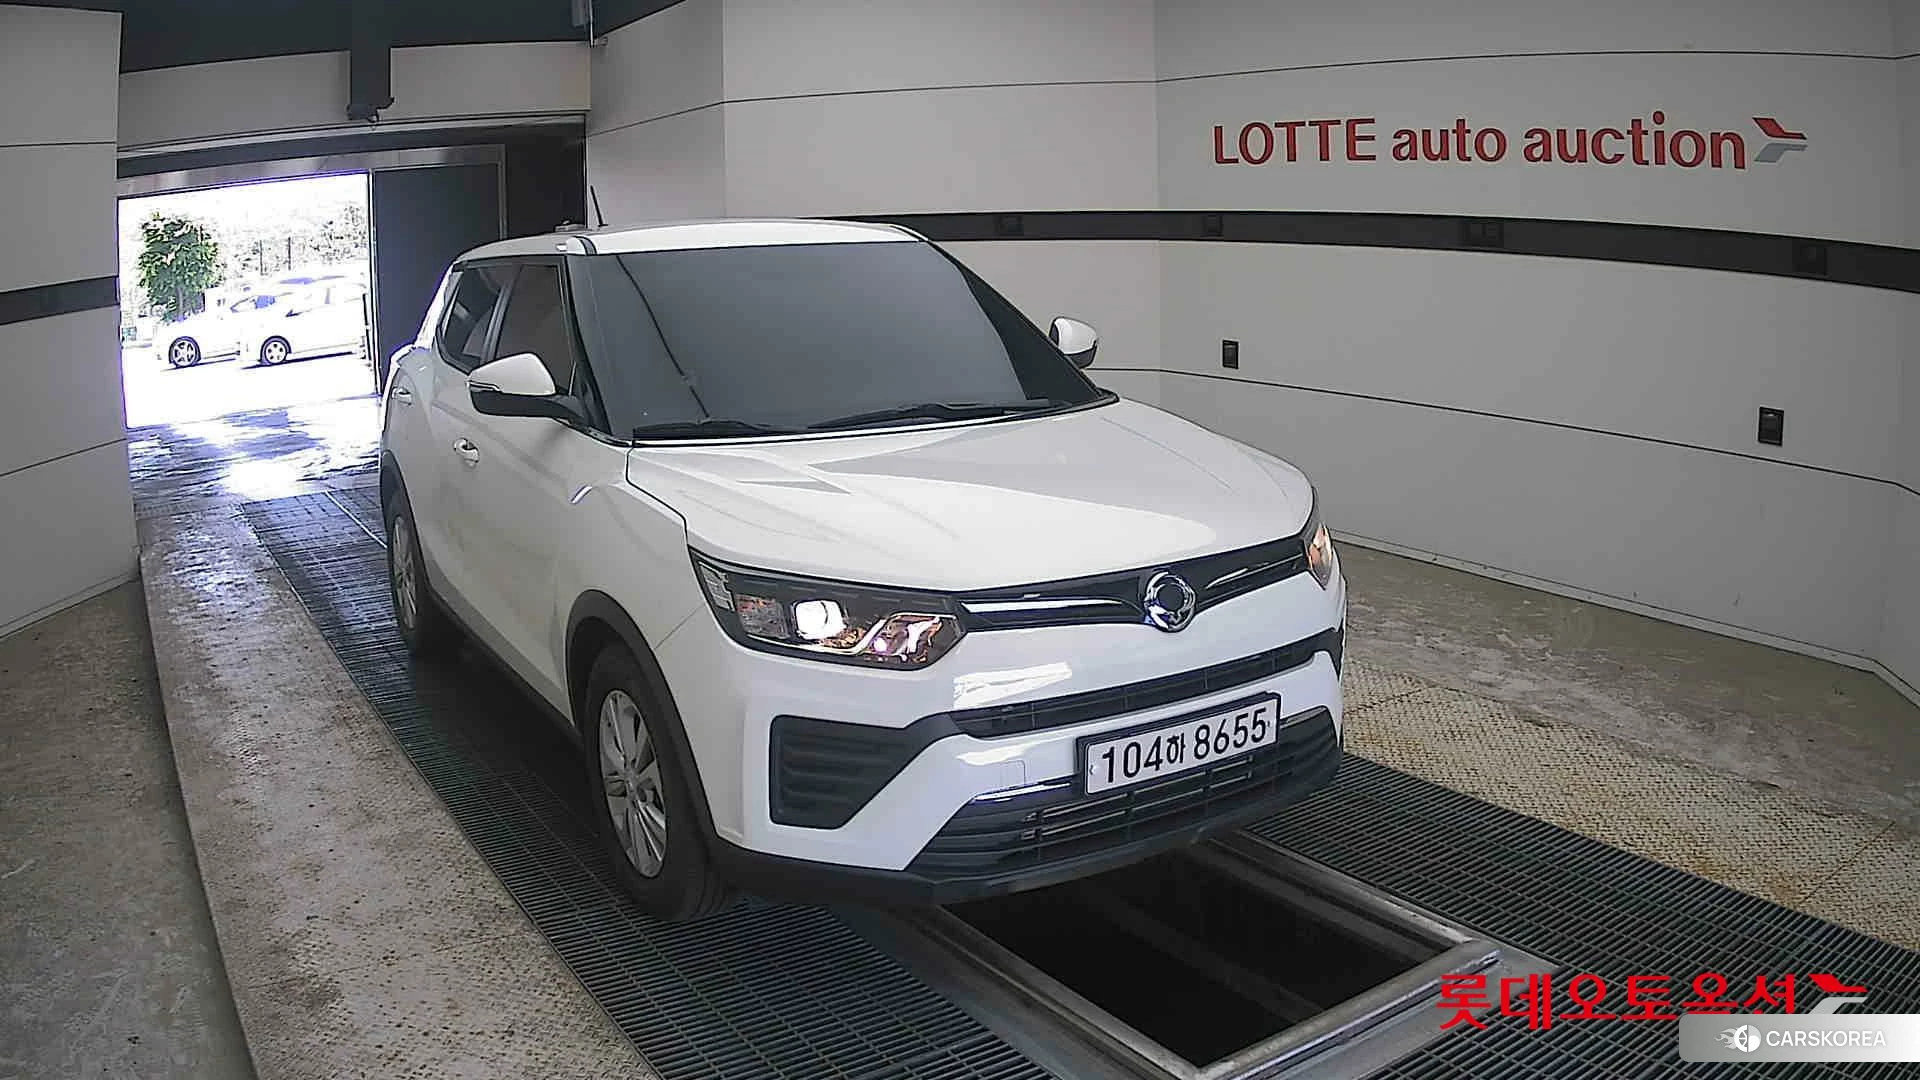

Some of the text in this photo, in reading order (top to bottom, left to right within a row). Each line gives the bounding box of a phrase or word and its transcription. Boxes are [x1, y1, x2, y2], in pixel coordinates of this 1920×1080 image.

[1213, 111, 1746, 169] LOTTE auto auction
[1102, 707, 1268, 784] 104하 8655
